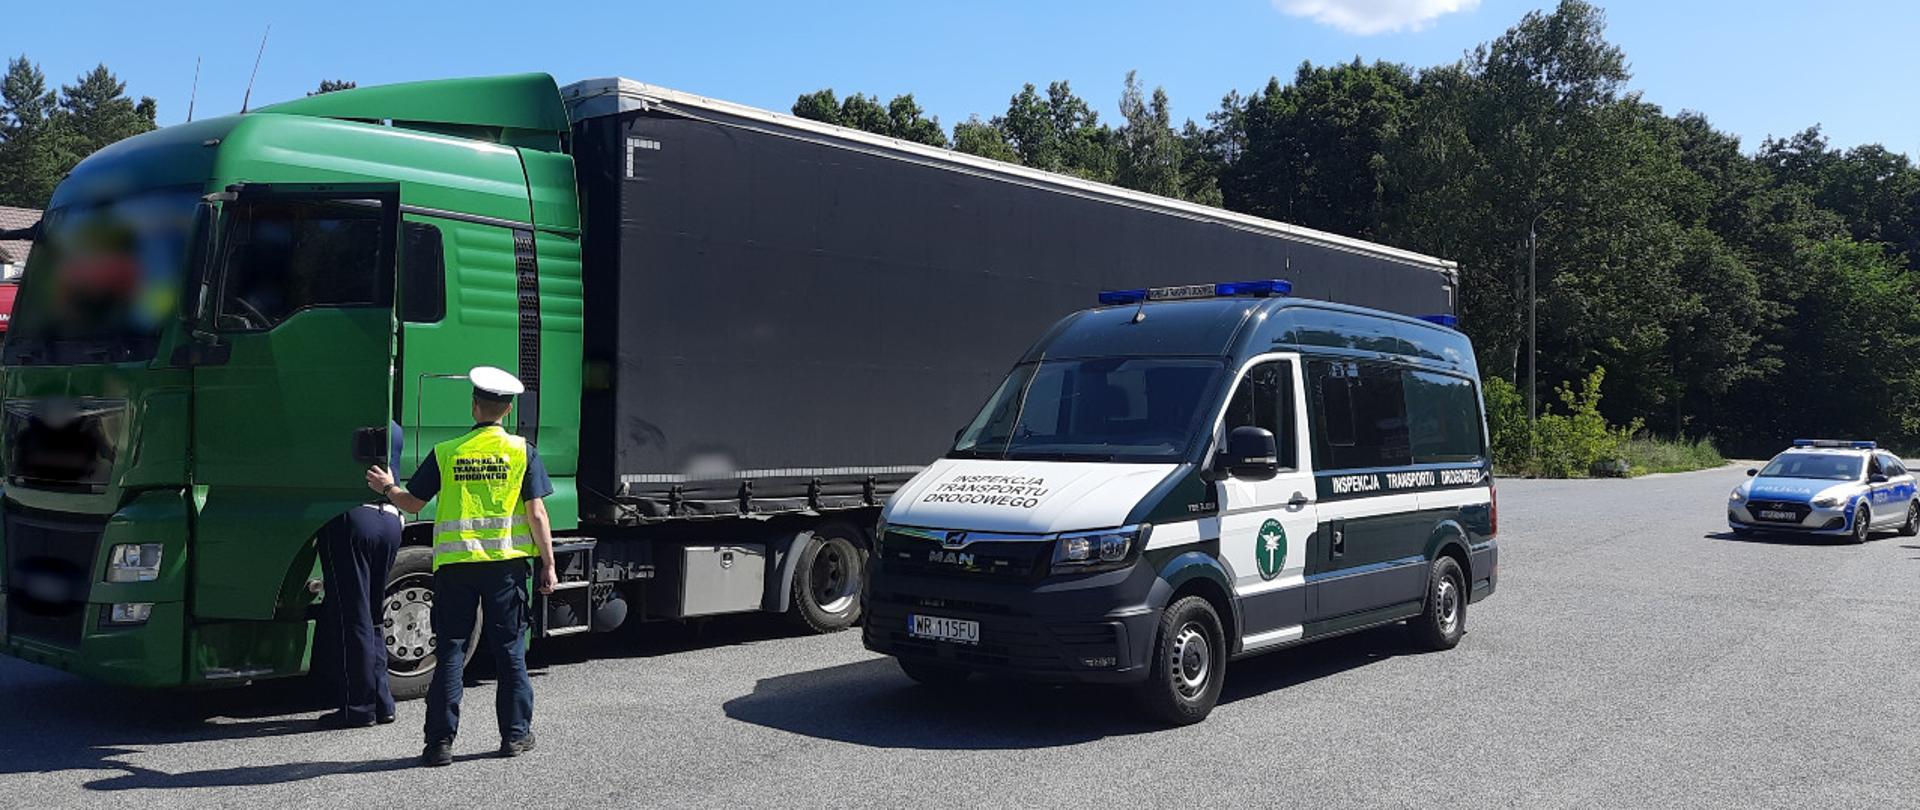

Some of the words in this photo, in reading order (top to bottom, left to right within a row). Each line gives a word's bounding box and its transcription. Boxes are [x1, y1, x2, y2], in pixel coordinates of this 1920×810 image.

[952, 475, 1044, 486] INSPEKCJA
[1332, 474, 1380, 494] INSPEKCJA
[1386, 471, 1435, 489] TRANSPORTU
[1441, 469, 1480, 485] DROGOWEGO
[936, 483, 1048, 497] TRANSPORTU
[1755, 485, 1811, 495] POLICJA
[923, 493, 1038, 509] DROGOWEGO
[928, 550, 975, 566] MAN
